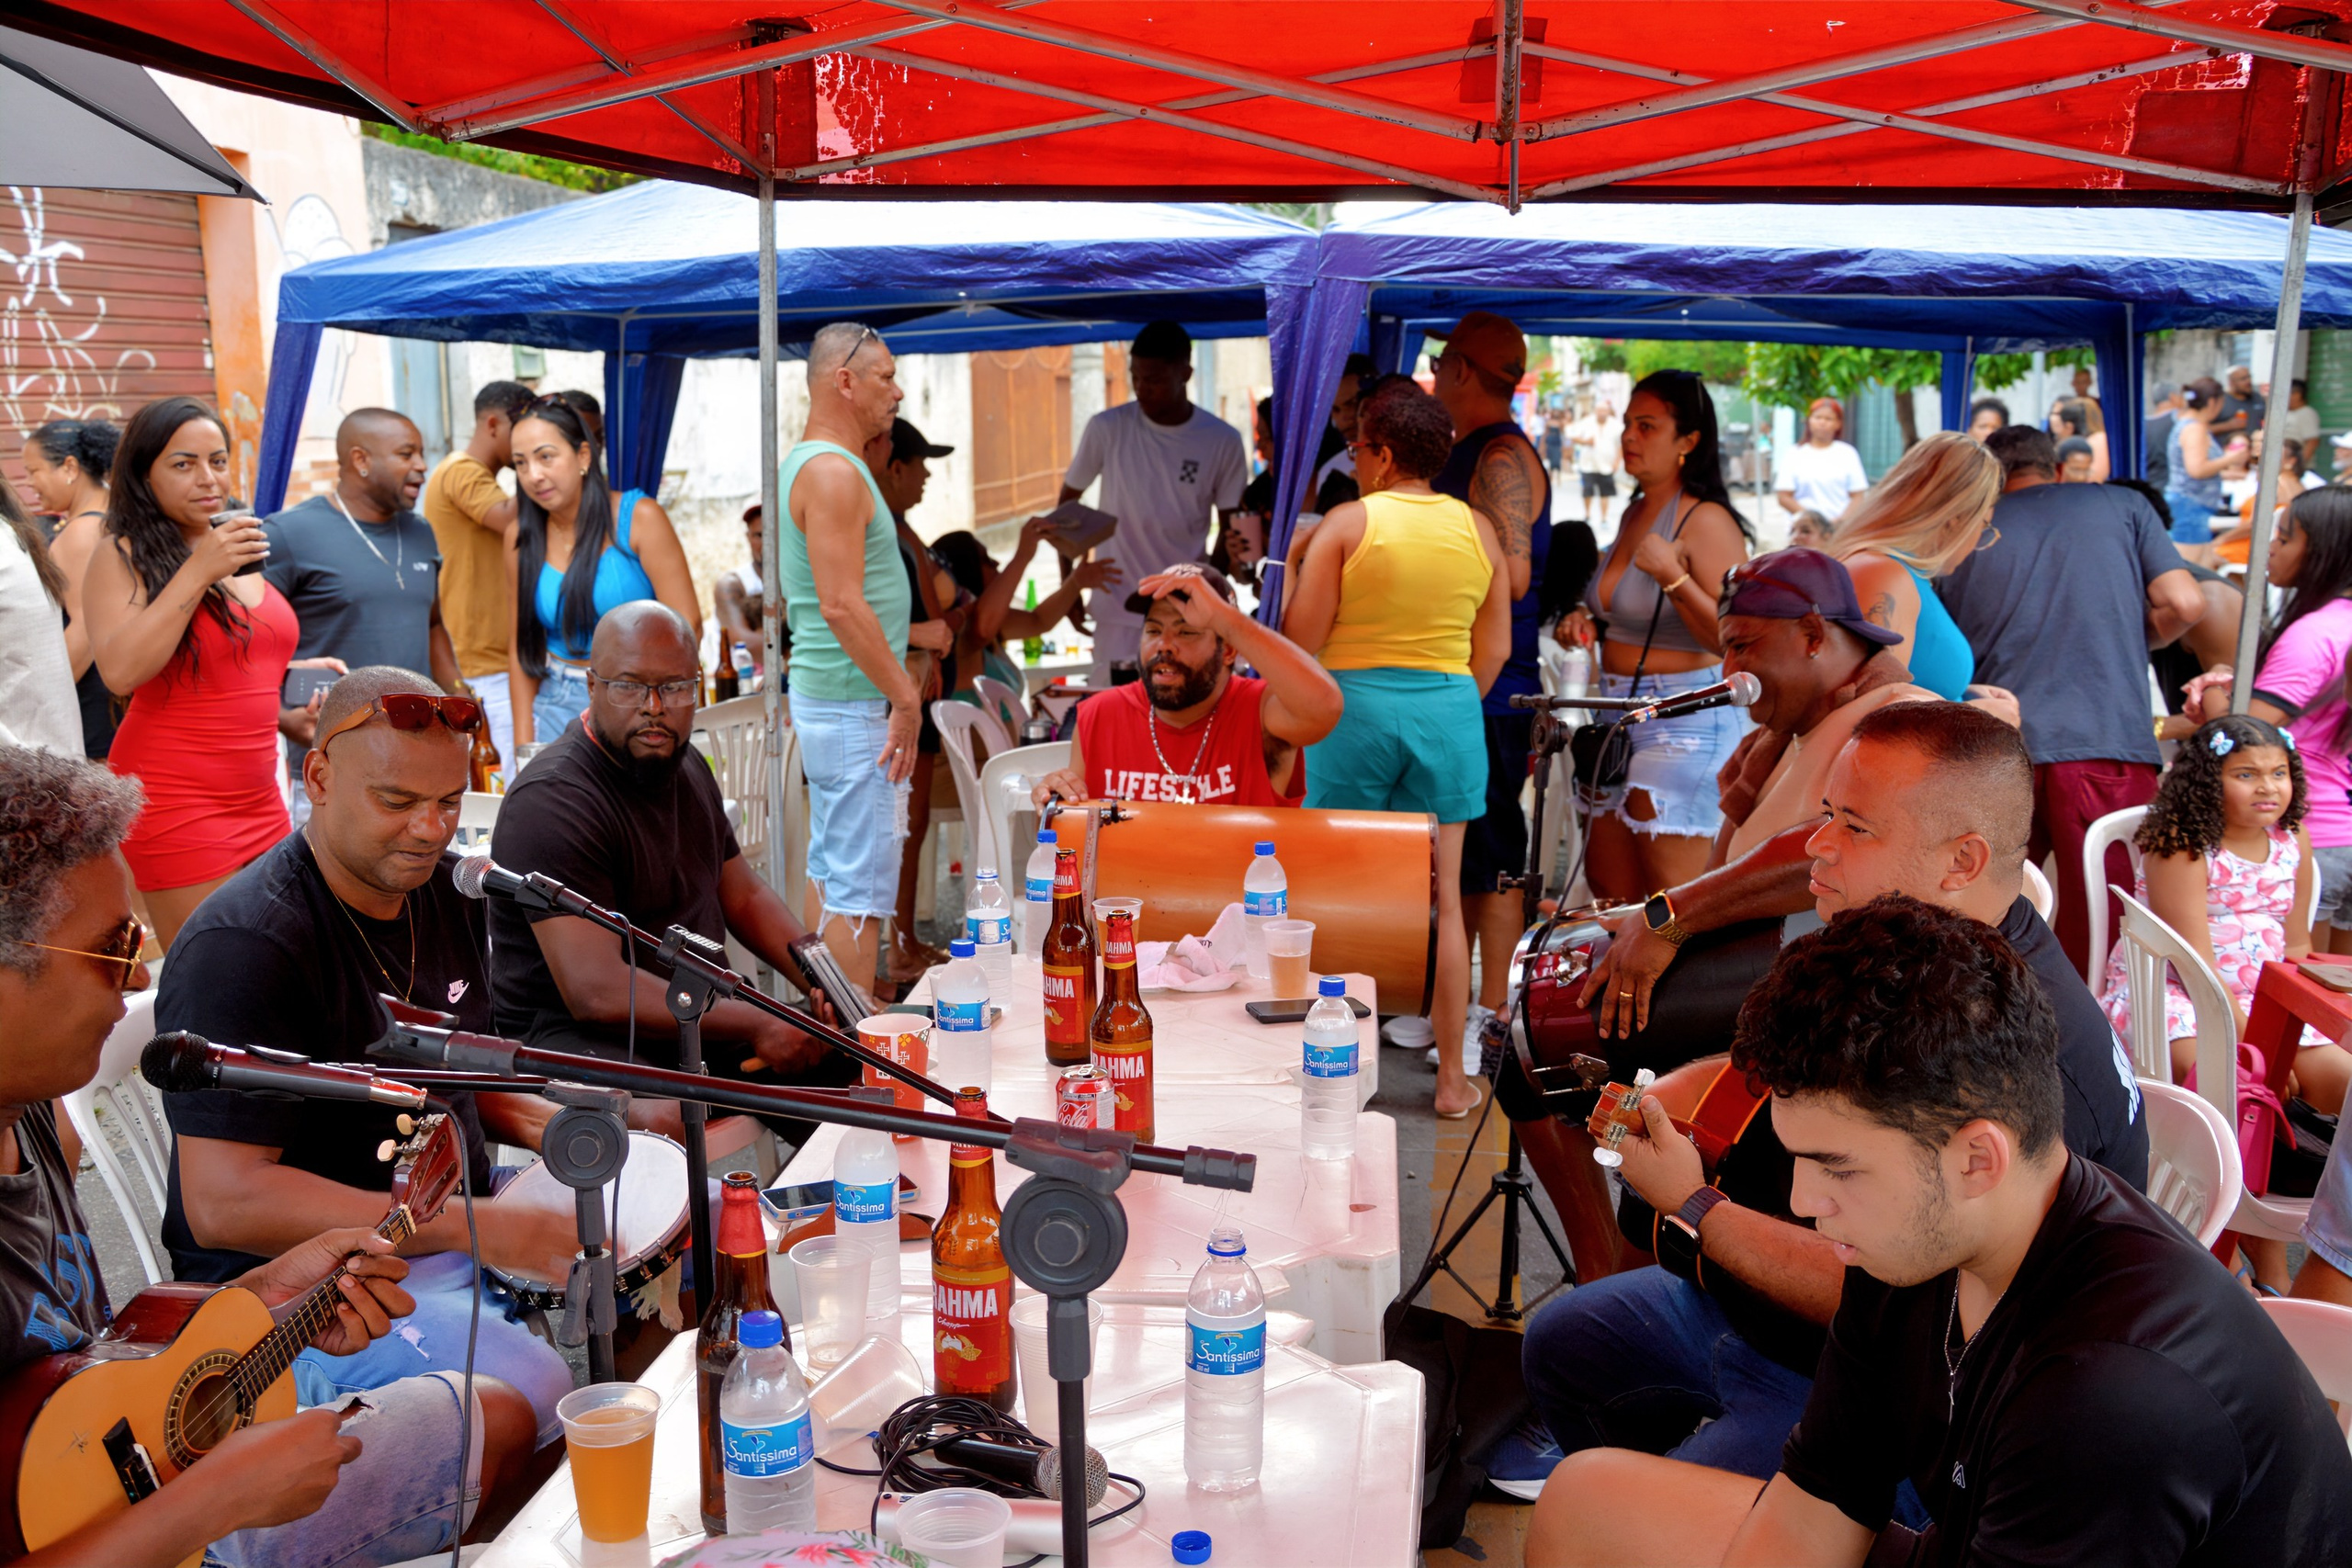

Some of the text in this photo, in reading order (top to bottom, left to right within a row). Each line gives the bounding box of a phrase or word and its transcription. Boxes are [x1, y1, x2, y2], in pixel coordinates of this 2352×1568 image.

[1104, 764, 1236, 803] LIFESTYLE
[1305, 1053, 1349, 1069] Santissima
[835, 1192, 885, 1213] Santissima
[1195, 1342, 1261, 1362] Santissima
[726, 1439, 797, 1463] Santissima
